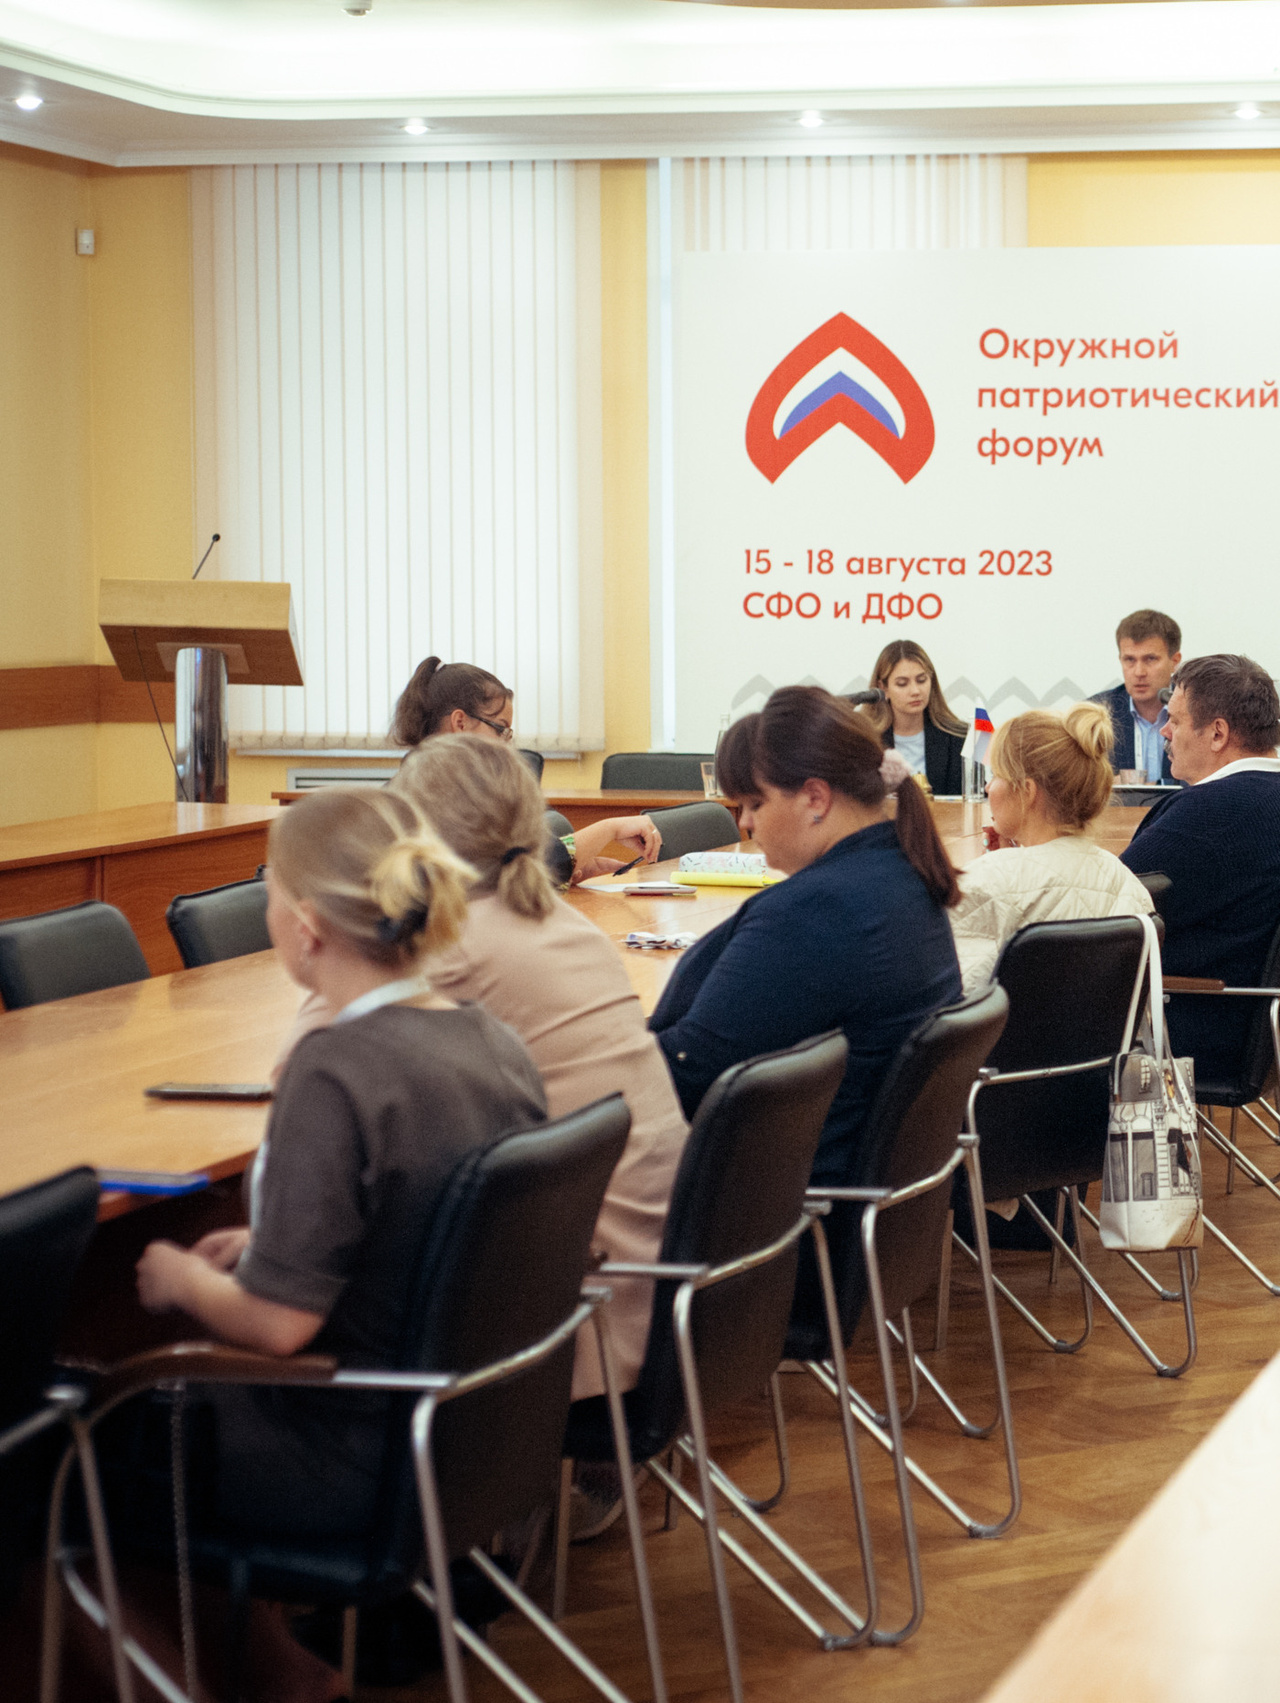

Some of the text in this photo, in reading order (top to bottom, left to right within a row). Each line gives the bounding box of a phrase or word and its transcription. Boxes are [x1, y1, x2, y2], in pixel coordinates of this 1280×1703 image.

[978, 328, 1179, 365] Окружной
[977, 381, 1279, 416] патриотический
[976, 428, 1104, 466] форум
[744, 549, 771, 574] 15
[806, 549, 834, 575] 18
[845, 557, 966, 582] августа
[977, 550, 1053, 576] 2023
[742, 591, 944, 624] СФО и ДФО
